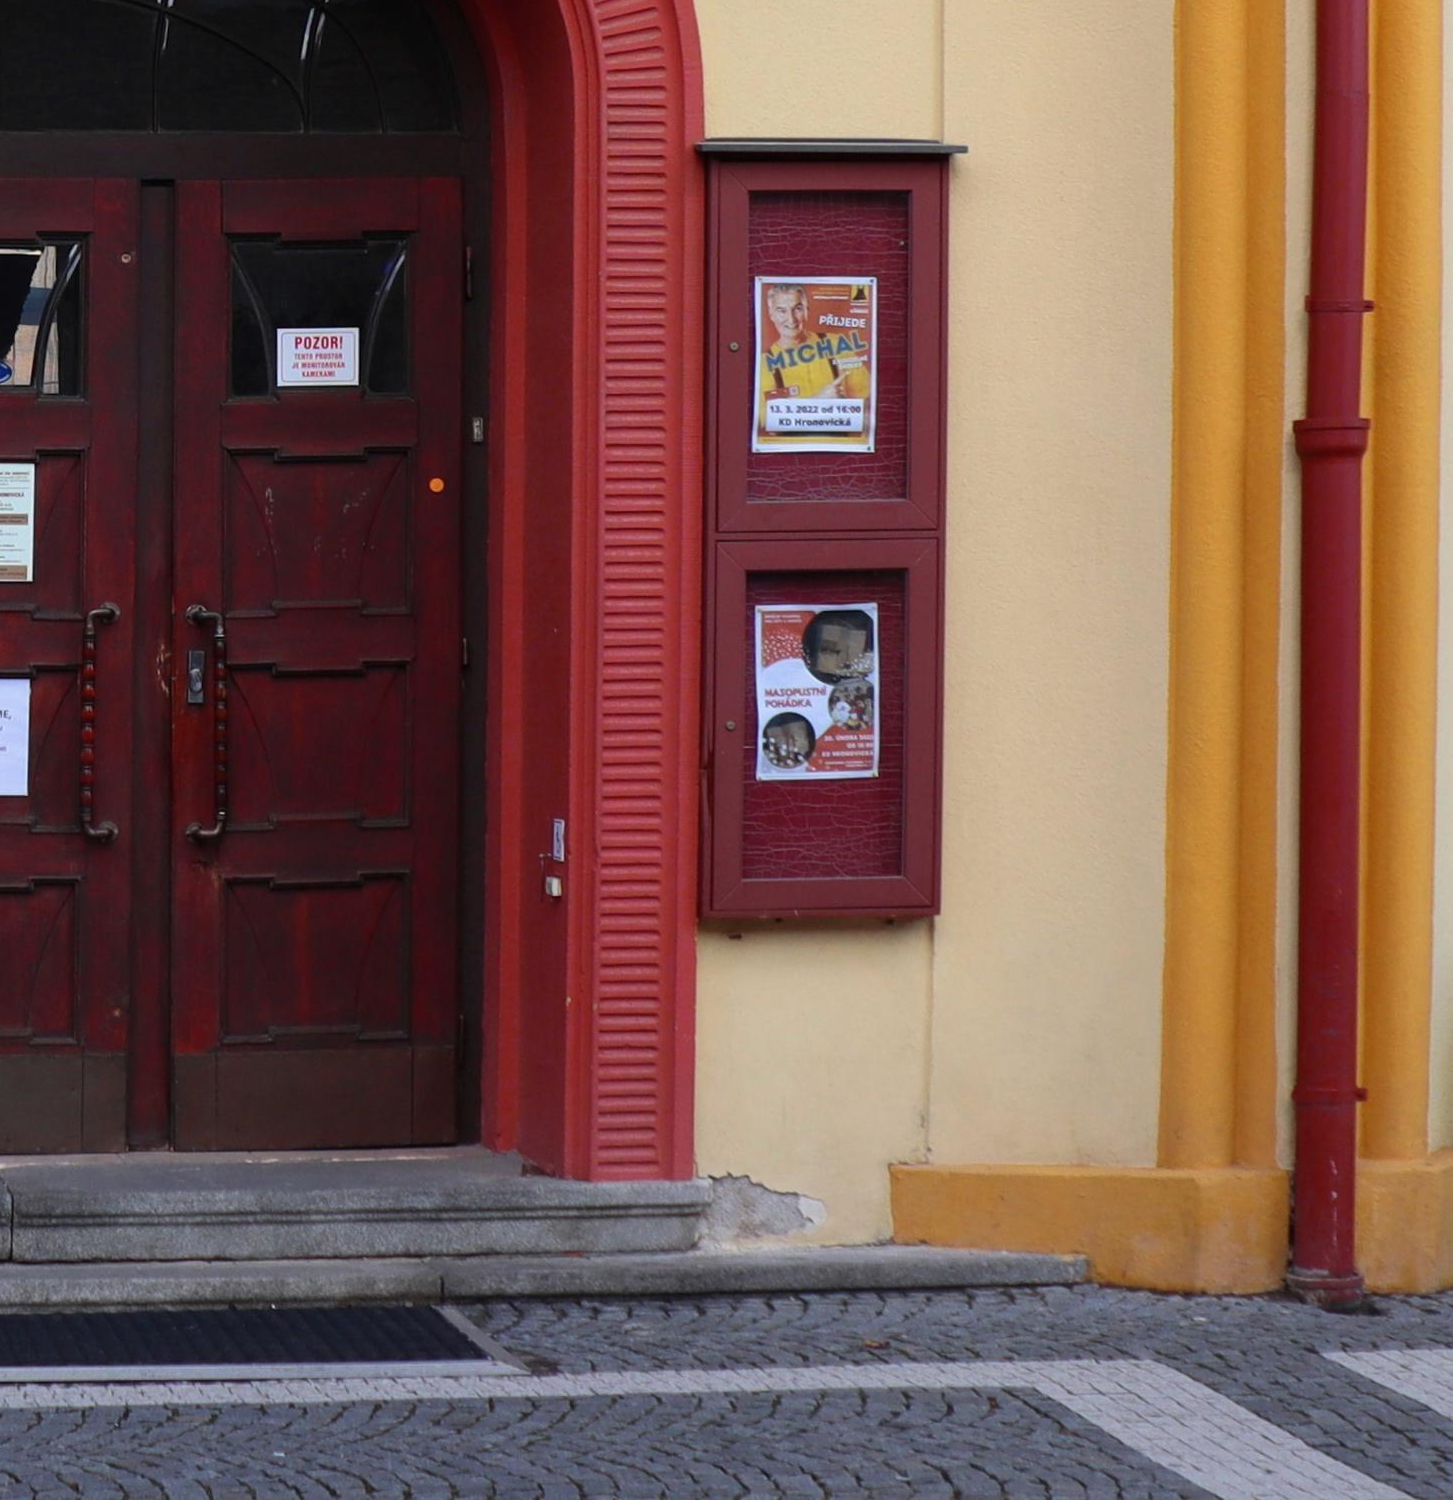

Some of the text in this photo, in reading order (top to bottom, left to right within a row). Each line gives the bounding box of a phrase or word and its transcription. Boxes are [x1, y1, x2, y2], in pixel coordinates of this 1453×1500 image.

[818, 313, 866, 329] PŘIJEDE
[294, 336, 343, 350] POZOR!
[766, 331, 868, 373] MICHAL
[778, 418, 792, 426] KD
